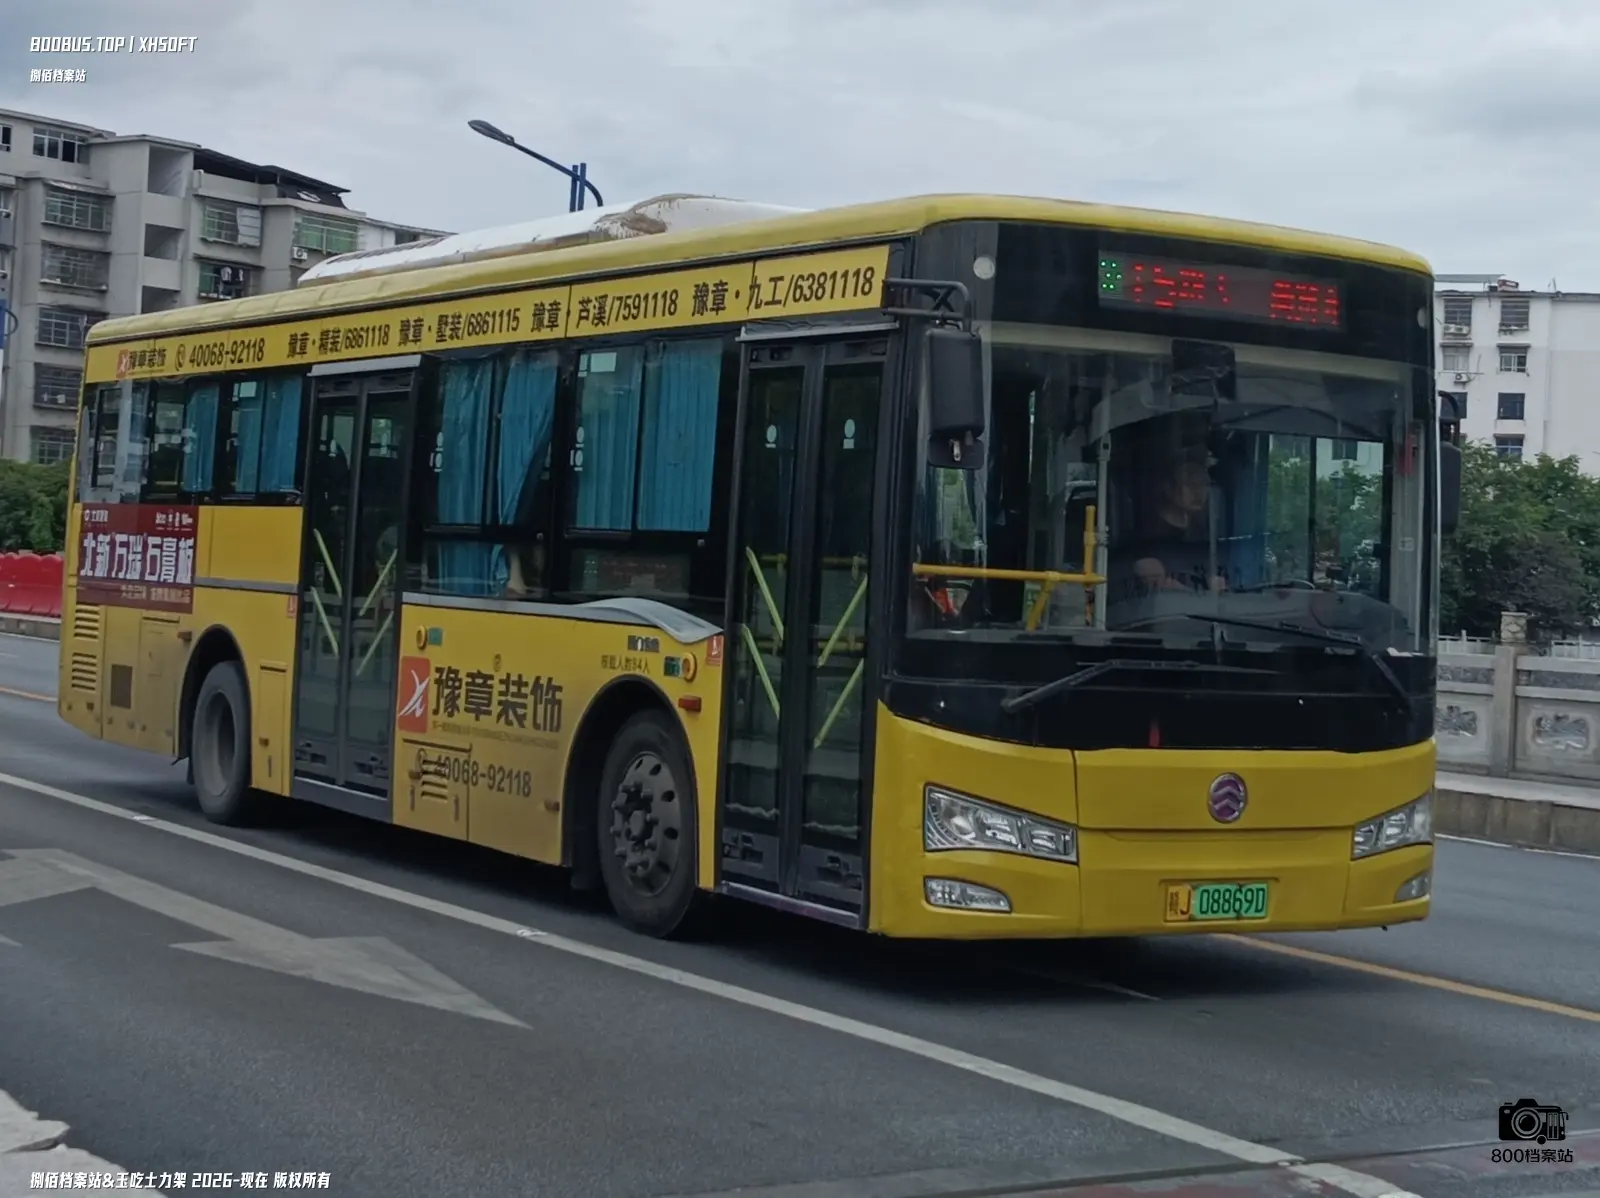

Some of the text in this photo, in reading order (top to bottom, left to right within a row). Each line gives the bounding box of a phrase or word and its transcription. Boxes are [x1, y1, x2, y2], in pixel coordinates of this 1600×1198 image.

[189, 338, 265, 367] 40068-92118
[432, 666, 563, 733] 豫章装饰
